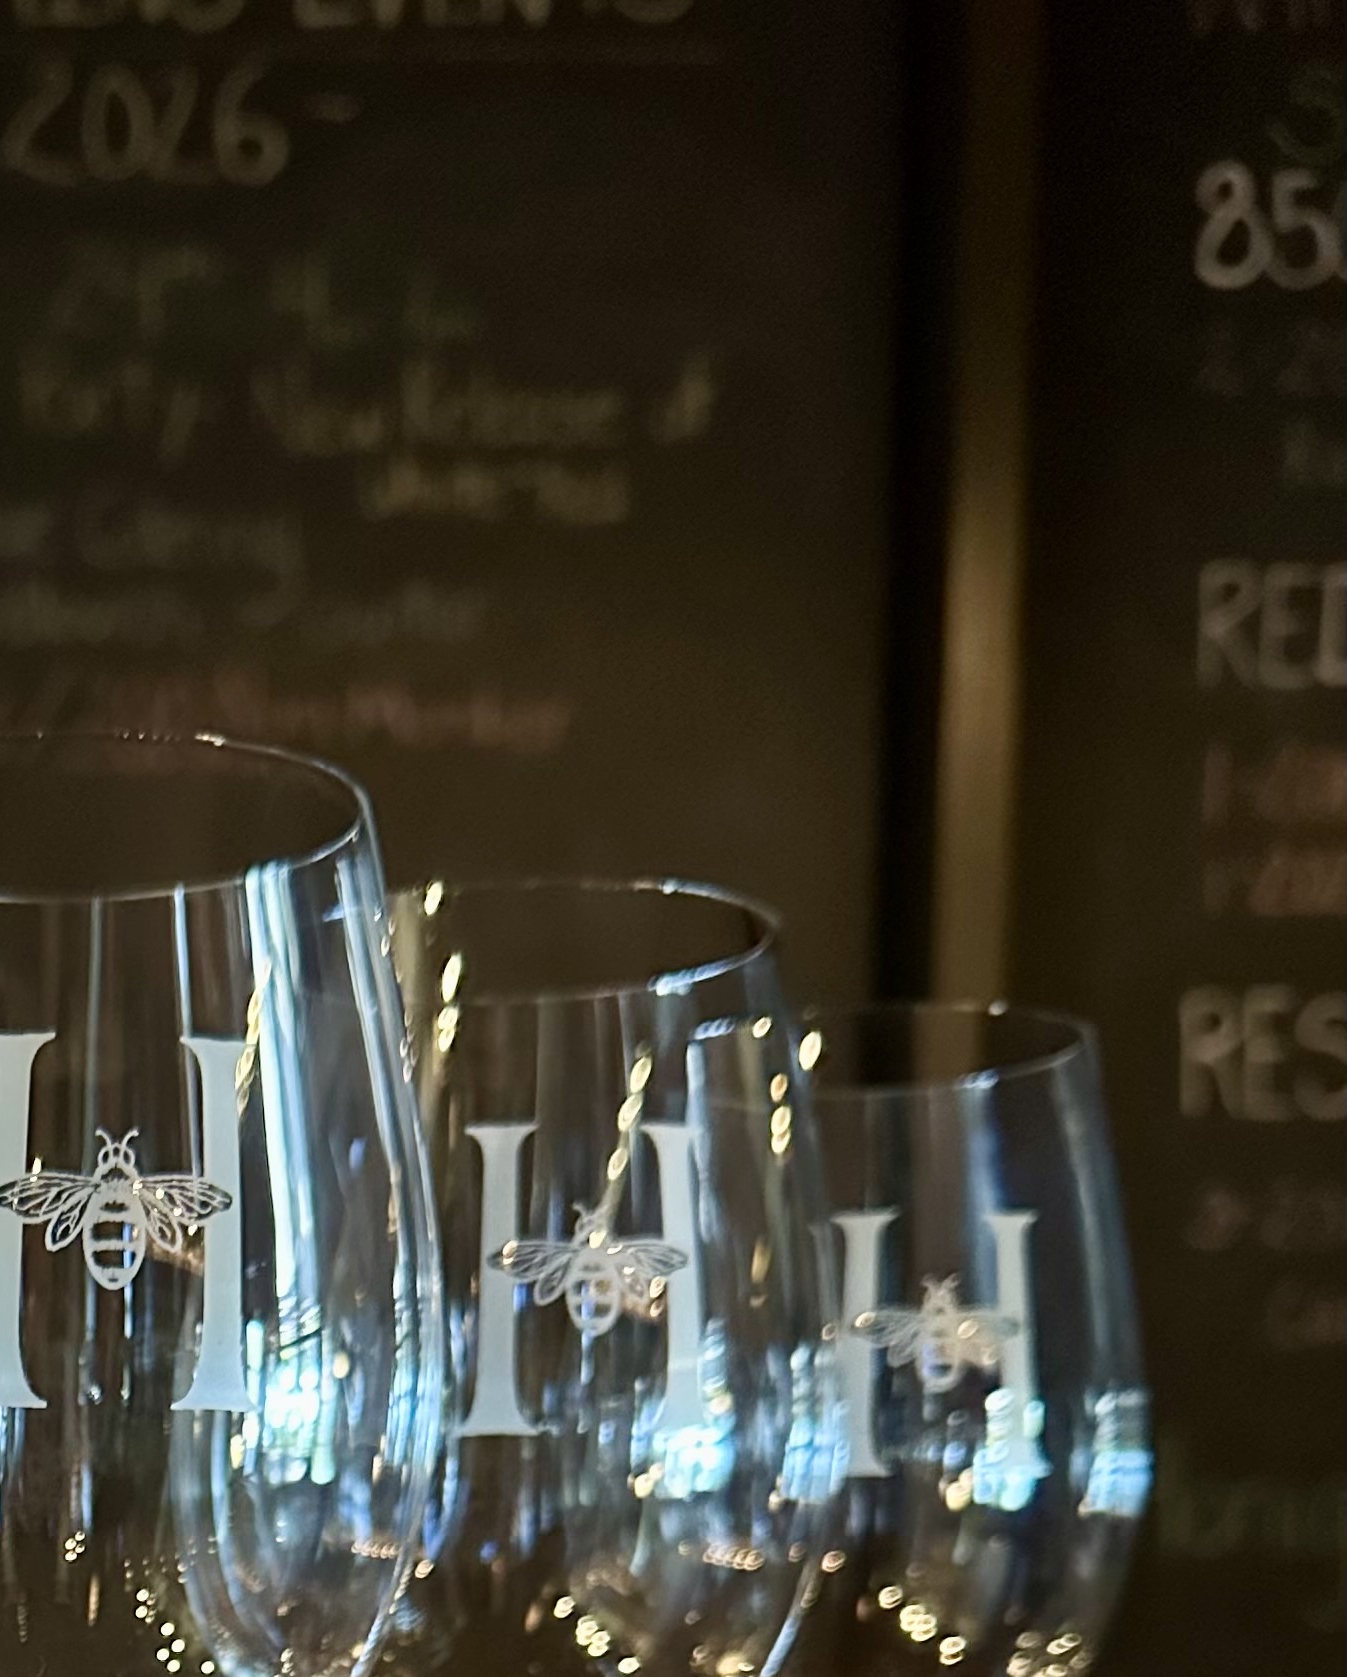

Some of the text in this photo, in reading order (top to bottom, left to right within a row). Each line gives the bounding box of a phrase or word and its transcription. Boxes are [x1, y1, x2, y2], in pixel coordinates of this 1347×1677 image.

[1, 55, 288, 187] 2026
[1194, 158, 1347, 290] 85
[1179, 984, 1347, 1121] RES
